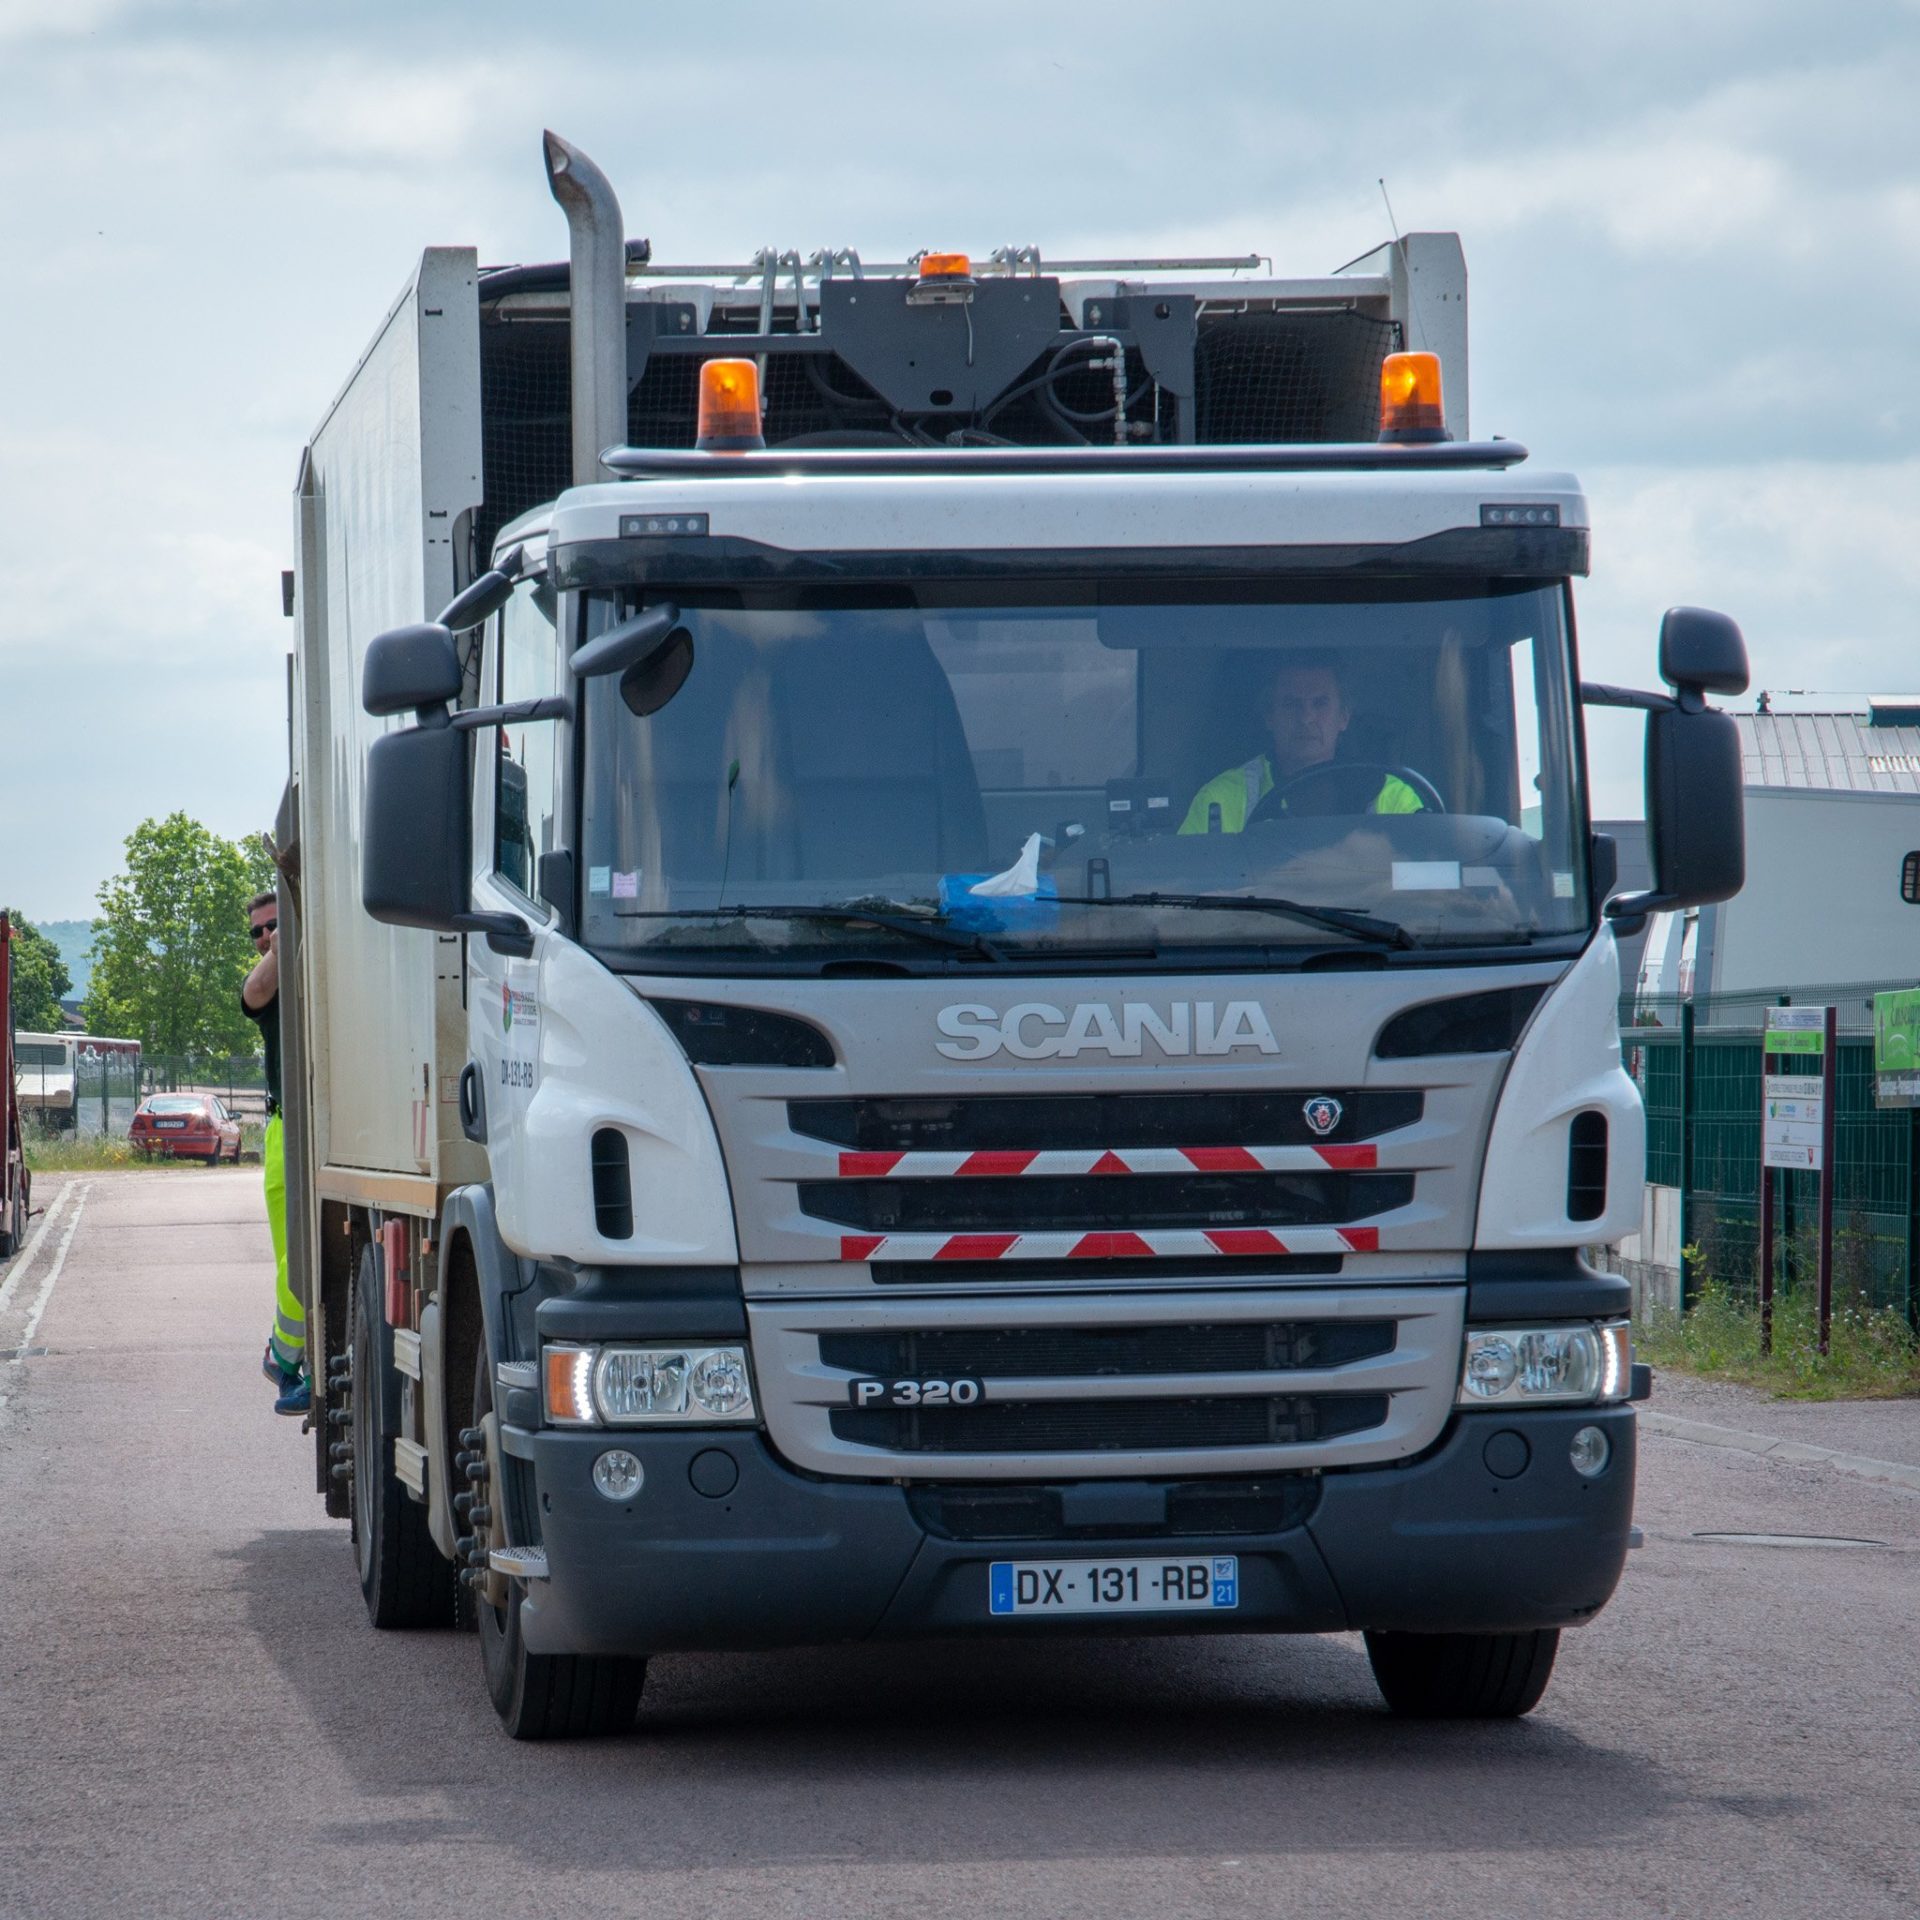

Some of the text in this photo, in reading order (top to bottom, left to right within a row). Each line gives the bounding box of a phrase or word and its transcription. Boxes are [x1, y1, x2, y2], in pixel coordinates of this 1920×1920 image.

[935, 1001, 1281, 1061] SCANIA
[857, 1379, 979, 1406] P 320
[999, 1593, 1006, 1604] F
[1216, 1585, 1233, 1602] 21
